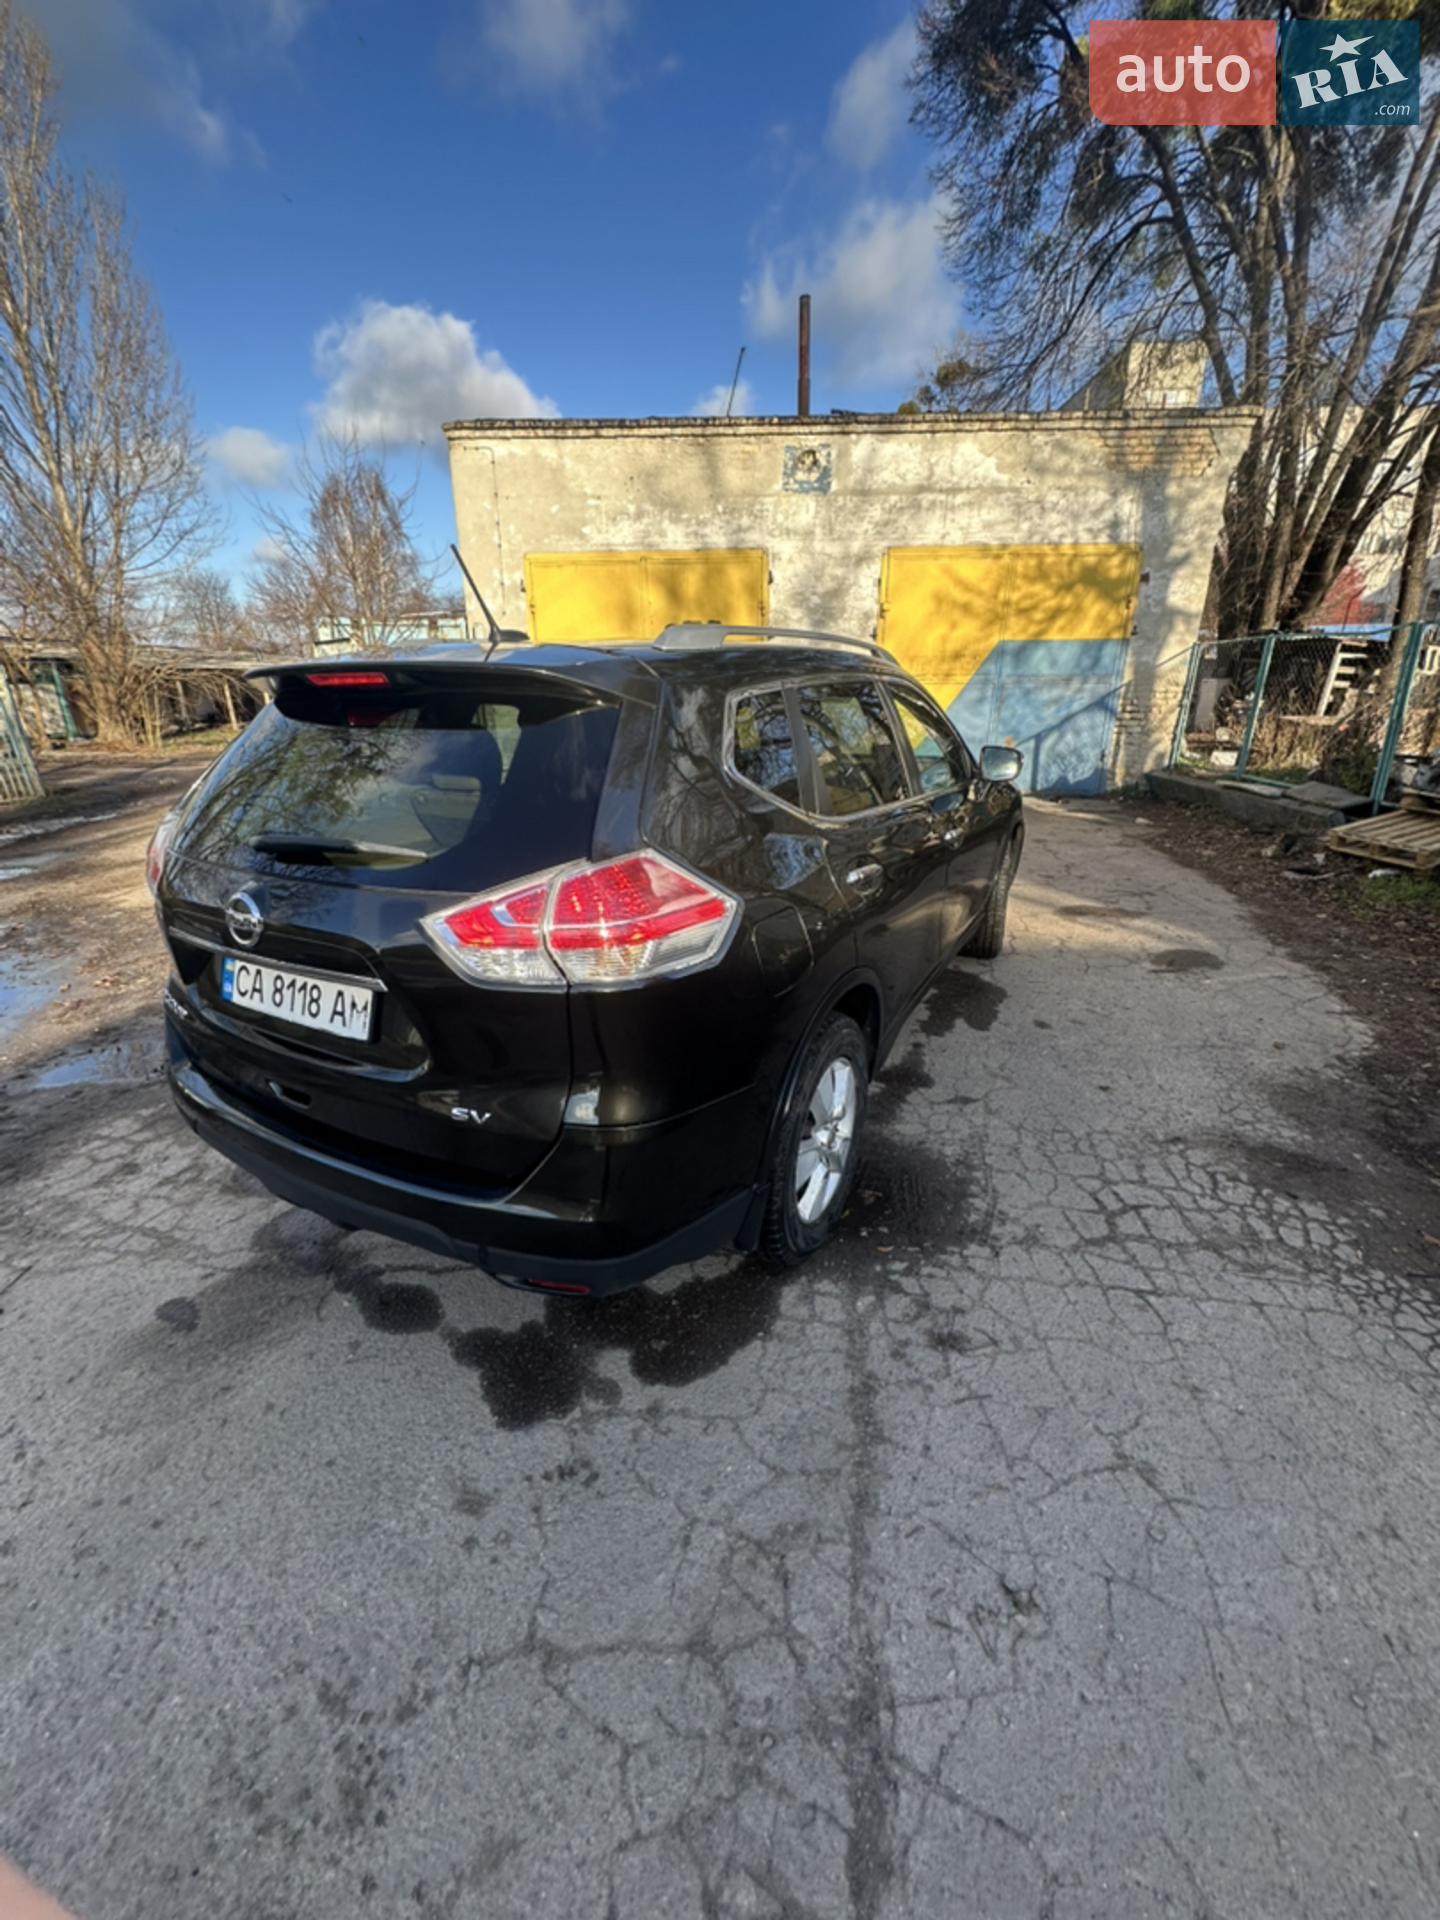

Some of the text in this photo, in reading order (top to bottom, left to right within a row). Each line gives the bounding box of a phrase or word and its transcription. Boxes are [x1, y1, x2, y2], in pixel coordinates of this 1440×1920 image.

[236, 964, 264, 1004] CA
[272, 974, 322, 1019] 8118
[329, 989, 369, 1033] AM
[451, 1107, 491, 1124] SV
